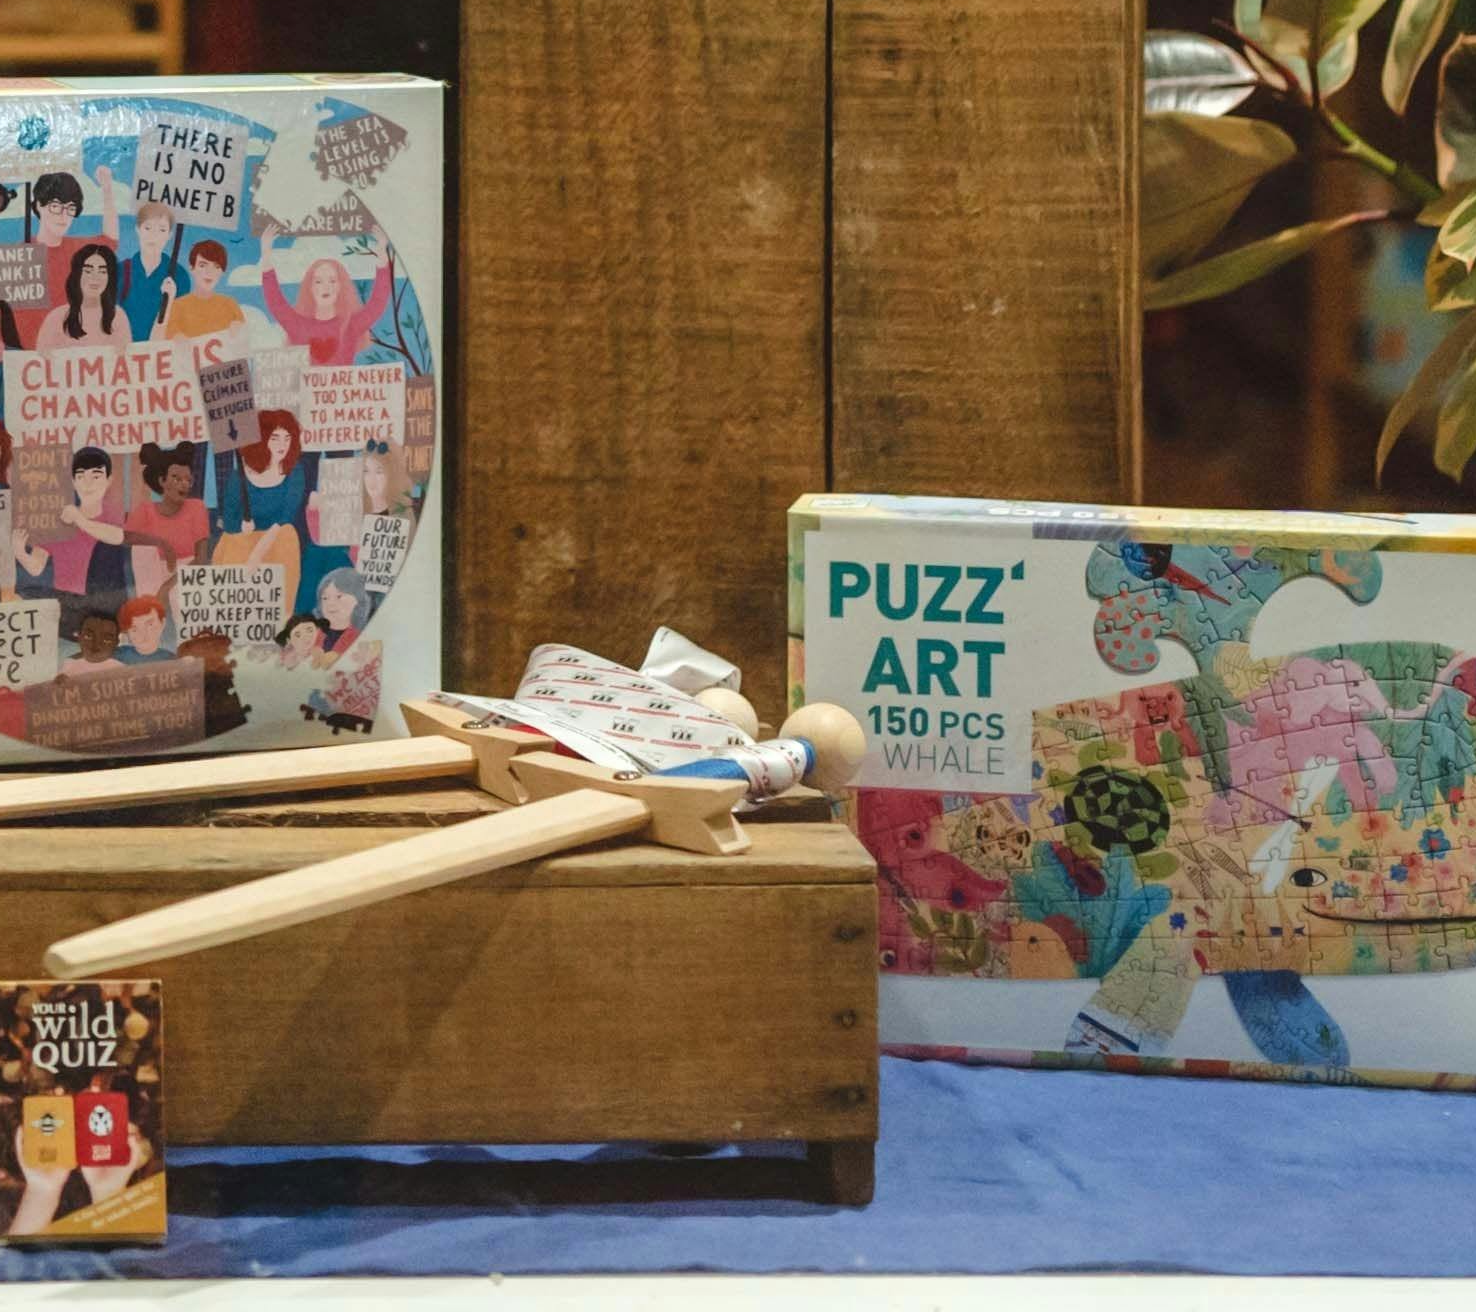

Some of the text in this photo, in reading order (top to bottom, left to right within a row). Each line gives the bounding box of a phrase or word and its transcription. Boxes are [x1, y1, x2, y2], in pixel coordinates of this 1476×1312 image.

[157, 123, 233, 159] THERE
[318, 115, 384, 146] THE SEA
[323, 129, 390, 163] LEVEL IS
[153, 151, 225, 185] IS NO
[328, 150, 381, 178] RISING
[136, 178, 236, 218] PLANET B
[302, 215, 334, 232] ARE
[339, 214, 364, 232] WE
[28, 264, 42, 280] IT
[5, 283, 46, 302] SAVED
[20, 338, 224, 392] CLIMATE IS
[199, 363, 244, 387] FUTURE
[303, 366, 402, 388] YOU ARE NEVER
[20, 381, 193, 421] CHANGING
[313, 389, 337, 405] TOO
[343, 388, 386, 403] SMALL
[208, 398, 256, 421] REFUGEE
[310, 406, 390, 424] TO MAKE A
[22, 415, 203, 447] WHY AREN'T WE
[302, 424, 394, 445] DIFFERENCE
[374, 517, 402, 535] OUR
[362, 532, 408, 551] FUTURE
[211, 567, 247, 585] WILL
[251, 567, 274, 585] GO
[361, 559, 393, 575] YOUR
[182, 586, 282, 607] TO SCHOOL IF
[179, 606, 281, 624] YOU KEEP THE
[246, 624, 278, 642] COOL
[861, 637, 1006, 699] ART
[91, 677, 137, 701] SURE
[146, 672, 179, 690] THE
[866, 704, 1006, 740] 150 PCS
[883, 743, 1006, 777] WHALE
[31, 1002, 67, 1016] YOUR
[32, 1000, 117, 1041] wild
[31, 1041, 118, 1074] QUIZ
